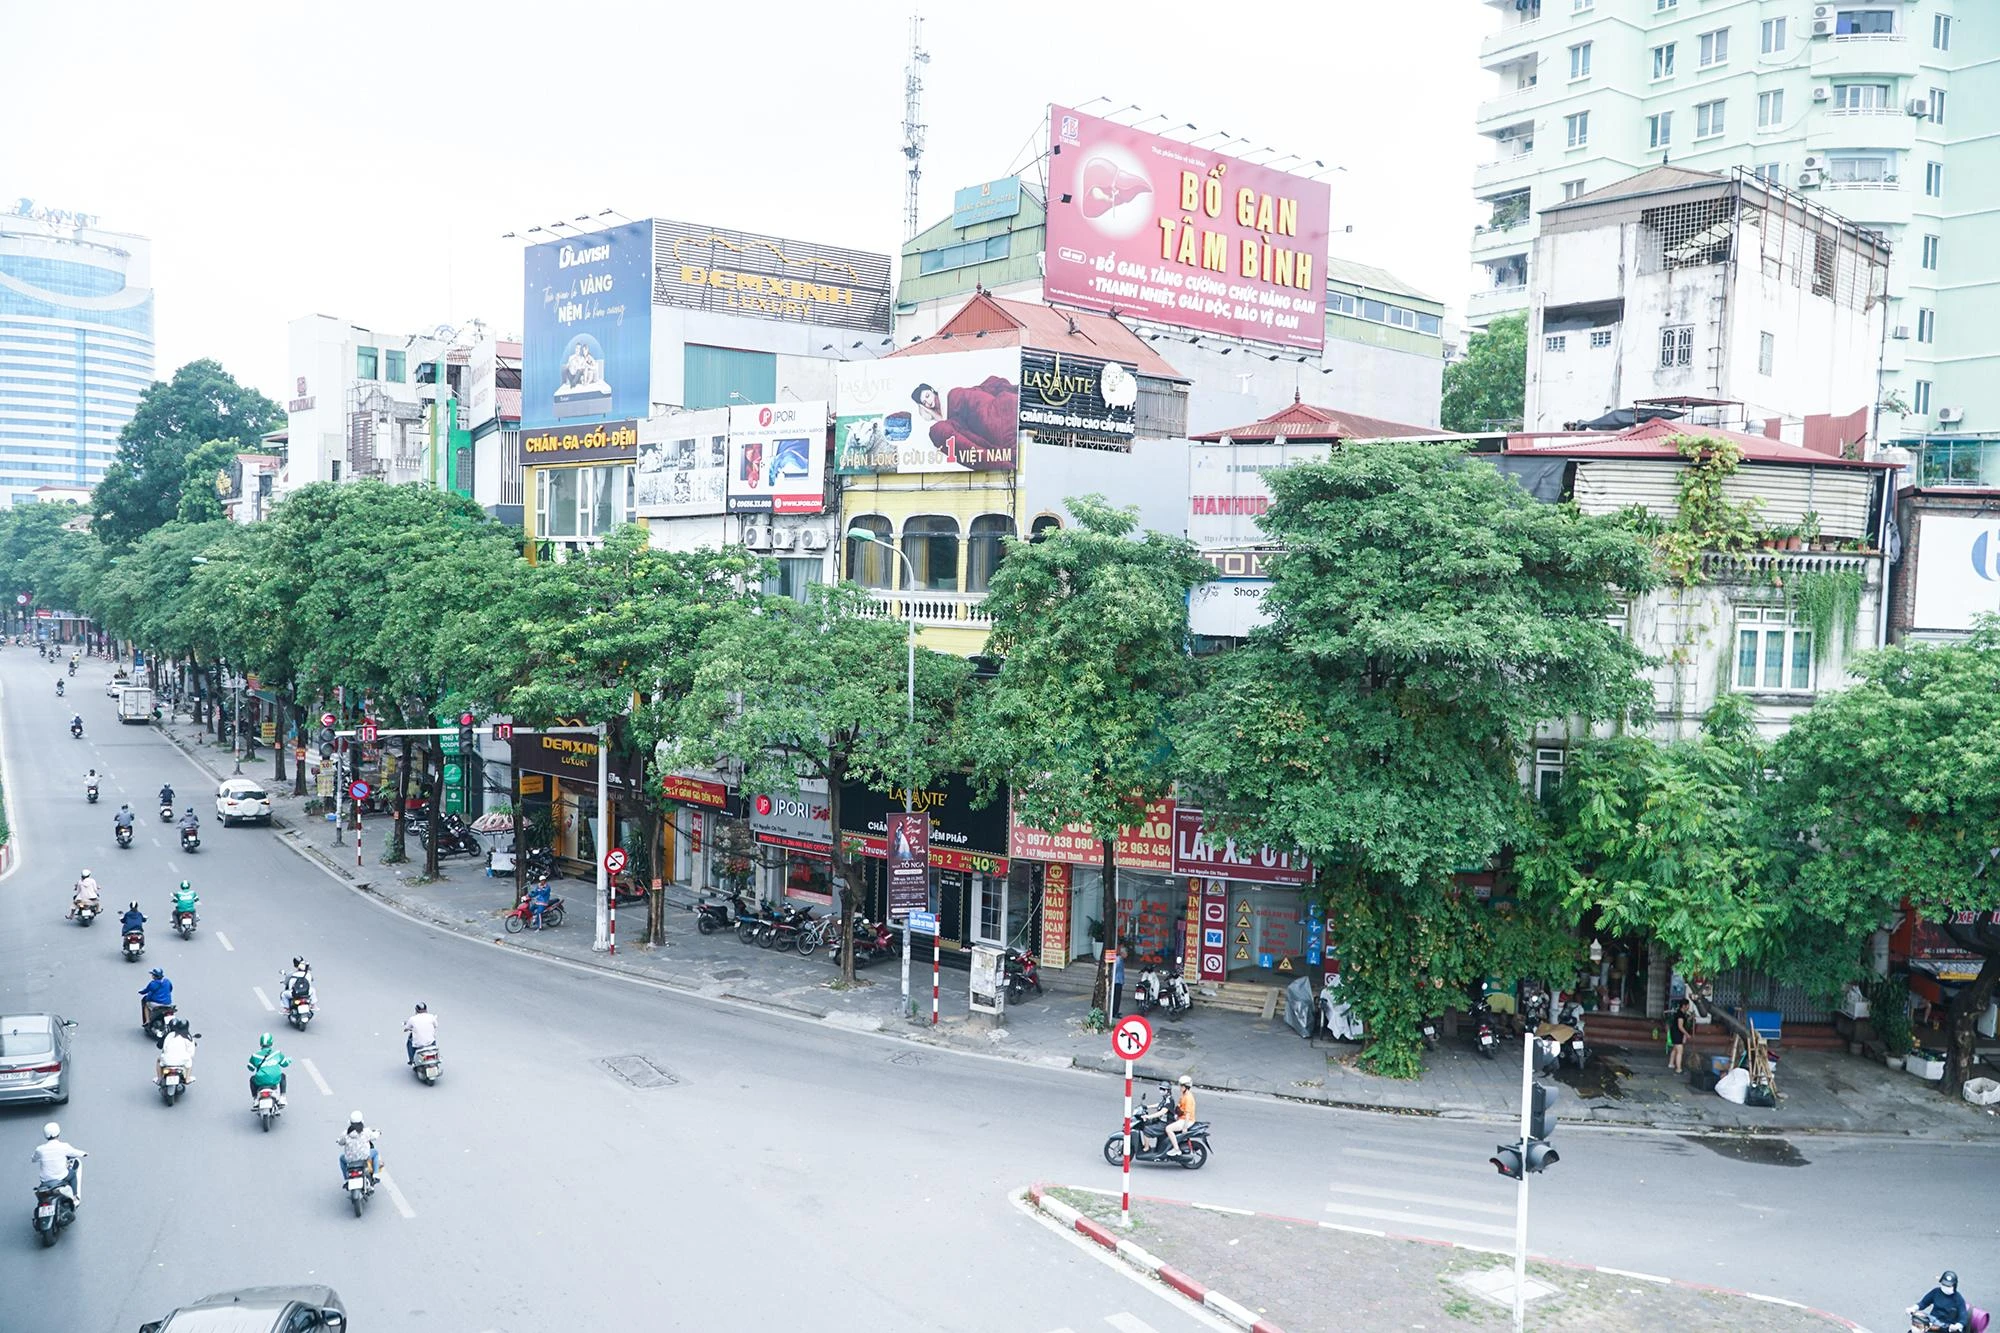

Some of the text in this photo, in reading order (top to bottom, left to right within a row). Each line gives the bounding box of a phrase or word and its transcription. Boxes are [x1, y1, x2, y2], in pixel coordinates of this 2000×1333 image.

[1181, 163, 1297, 237] BỔ GAN
[1159, 216, 1313, 291] TÂM BÌNH
[580, 273, 613, 296] VÀNG
[1117, 261, 1147, 282] GAN,
[1151, 266, 1183, 287] TĂNG
[1292, 297, 1317, 314] GAN
[728, 293, 813, 317] LUXURY
[1096, 277, 1139, 298] THANH
[1275, 314, 1299, 329] GAN
[558, 301, 583, 327] NỆM
[773, 410, 796, 425] JPORI
[1082, 418, 1100, 430] CAO
[946, 436, 957, 463] 1
[959, 447, 983, 465] VIỆT
[986, 448, 1011, 462] NAM
[1234, 587, 1260, 599] Shop
[498, 725, 511, 739] 17
[543, 737, 611, 756] DEMXIN
[561, 756, 588, 767] LUXURY
[760, 799, 809, 818] JP JPORI
[946, 830, 968, 844] PHÁP
[1027, 833, 1050, 847] 0977
[1054, 836, 1072, 848] 838
[1075, 837, 1093, 850] 090
[1130, 843, 1149, 855] 963
[1152, 843, 1171, 857] 454
[946, 853, 953, 864] 2
[973, 855, 1000, 873] 40%
[1067, 851, 1083, 861] Thanh
[1046, 884, 1064, 894] IN
[1188, 895, 1199, 907] IN
[1045, 910, 1064, 920] PHOTO
[1045, 923, 1063, 933] SCAN
